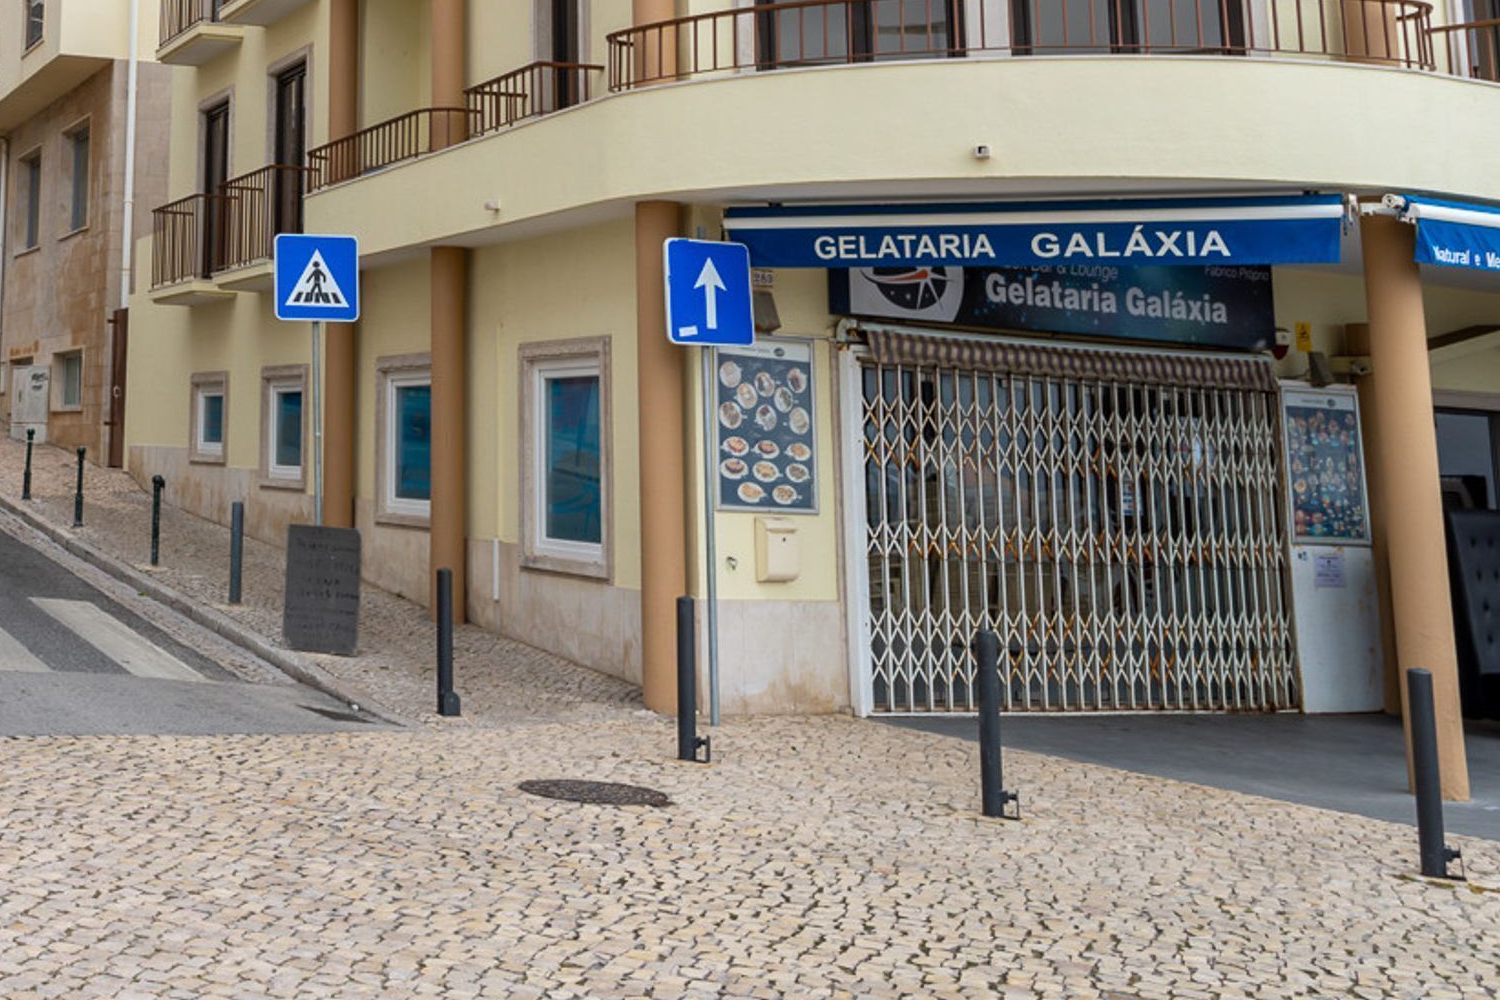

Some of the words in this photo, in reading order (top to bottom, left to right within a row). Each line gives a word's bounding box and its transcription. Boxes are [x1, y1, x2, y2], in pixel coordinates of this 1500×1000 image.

[814, 233, 996, 261] GELATARIA
[1031, 225, 1232, 258] GALÁXIA
[1433, 245, 1470, 266] Natural
[1474, 254, 1481, 266] e
[1071, 264, 1119, 282] Lounge
[985, 271, 1117, 314] Gelataria
[1126, 286, 1228, 324] Galáxia
